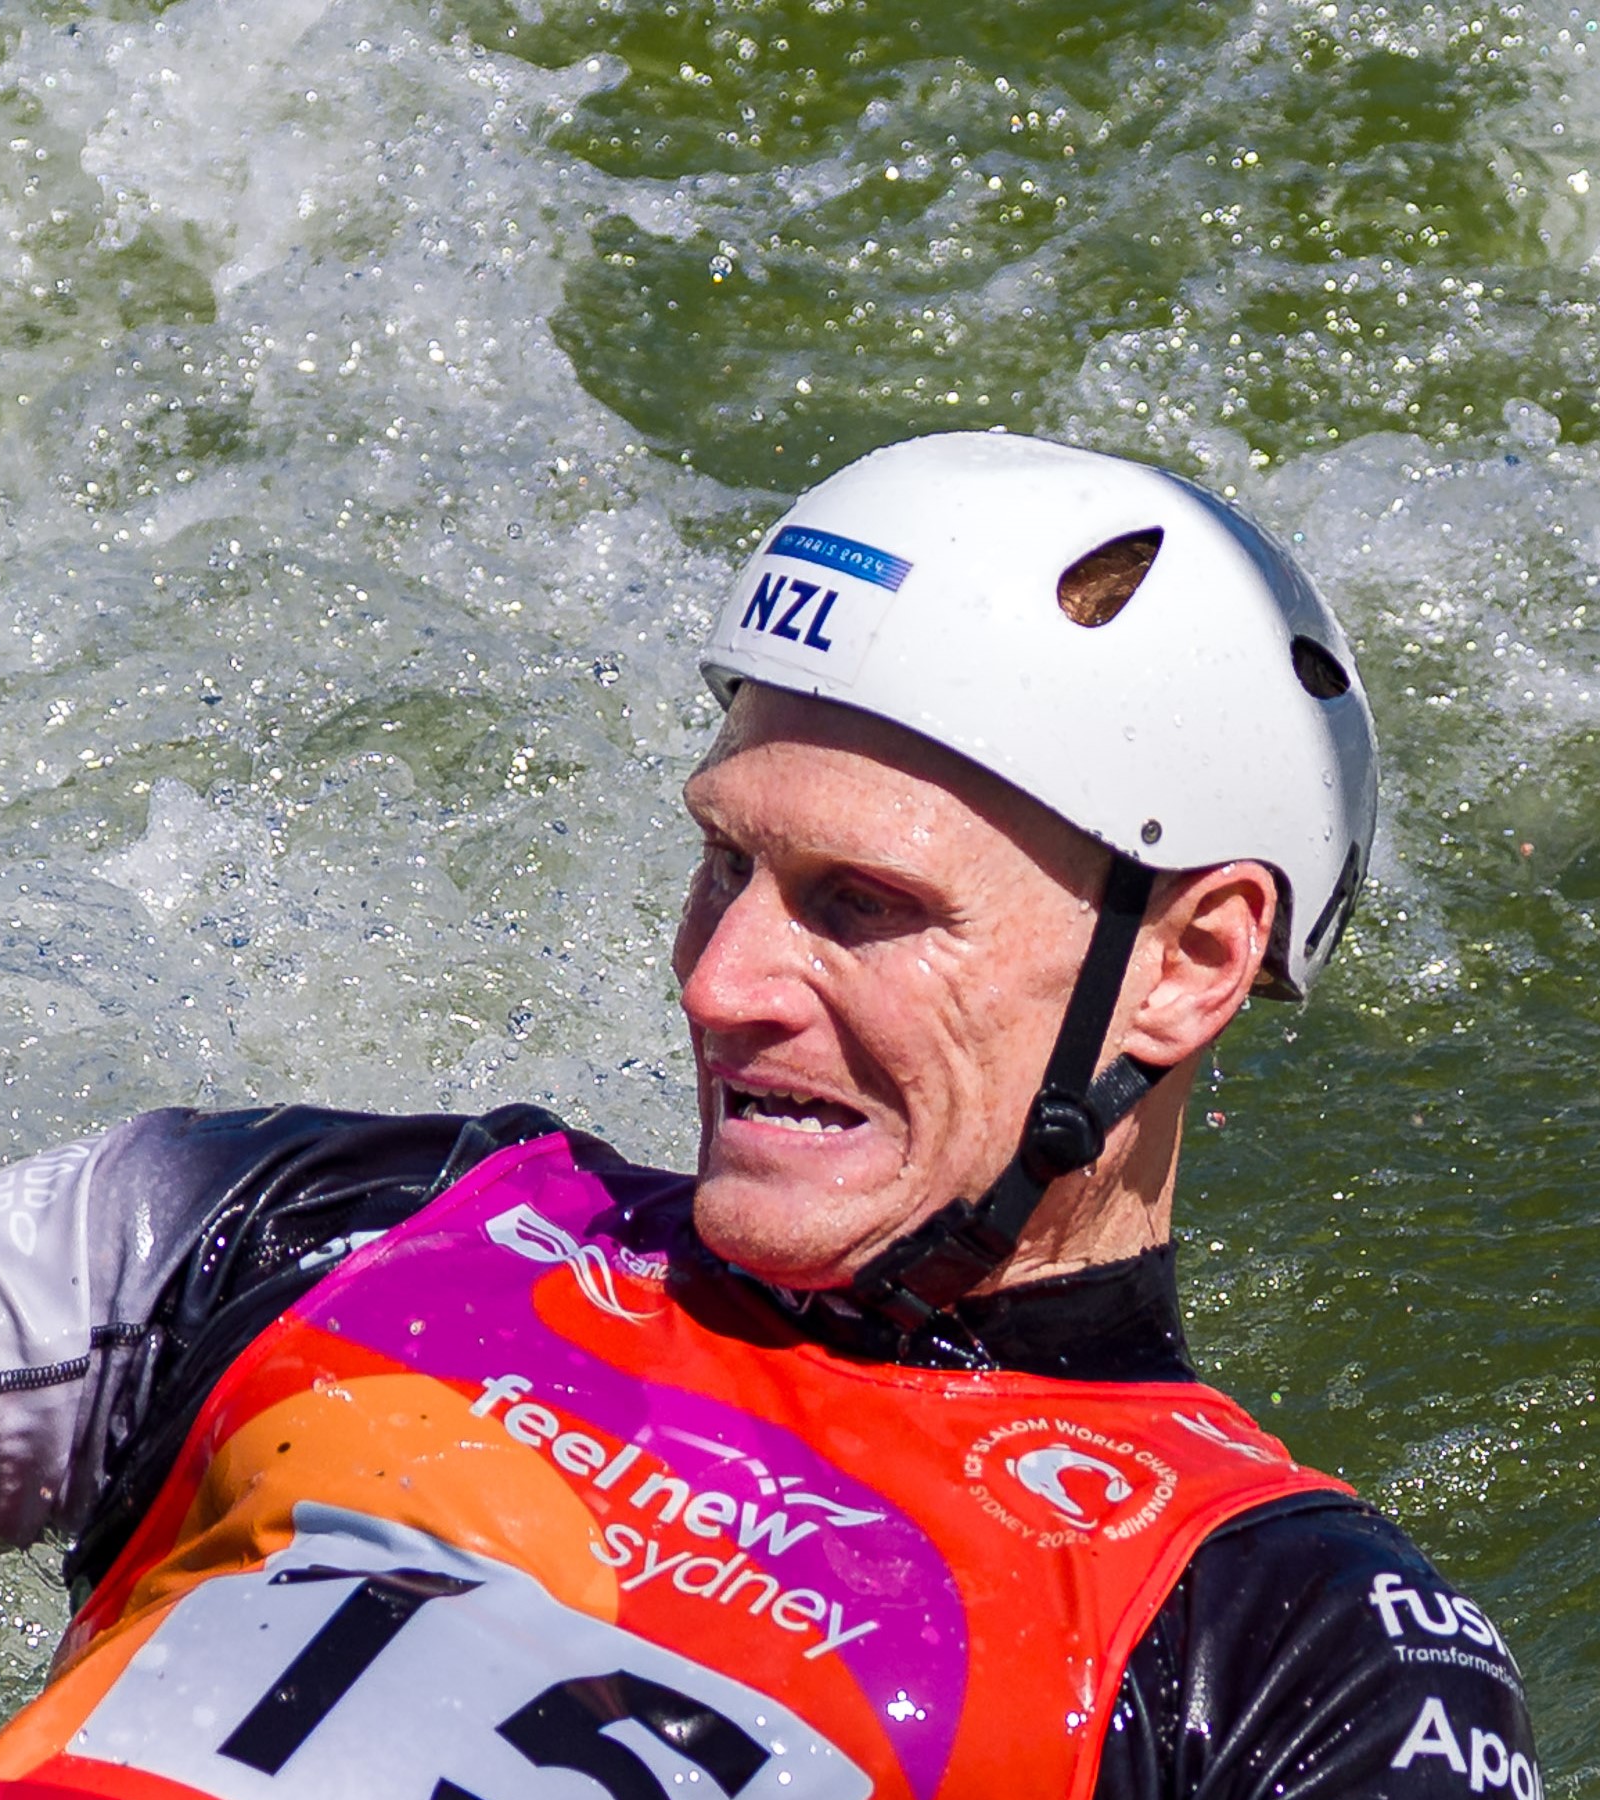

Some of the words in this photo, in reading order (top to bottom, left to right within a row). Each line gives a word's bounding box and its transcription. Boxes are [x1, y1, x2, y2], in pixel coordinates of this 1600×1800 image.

[740, 572, 838, 652] NZL
[468, 1373, 641, 1491] feel
[632, 1475, 820, 1558] new
[972, 1417, 1050, 1453] SLALOM
[1055, 1418, 1134, 1454] WORLD
[969, 1485, 1035, 1539] SYDNEY
[589, 1522, 880, 1661] sydney
